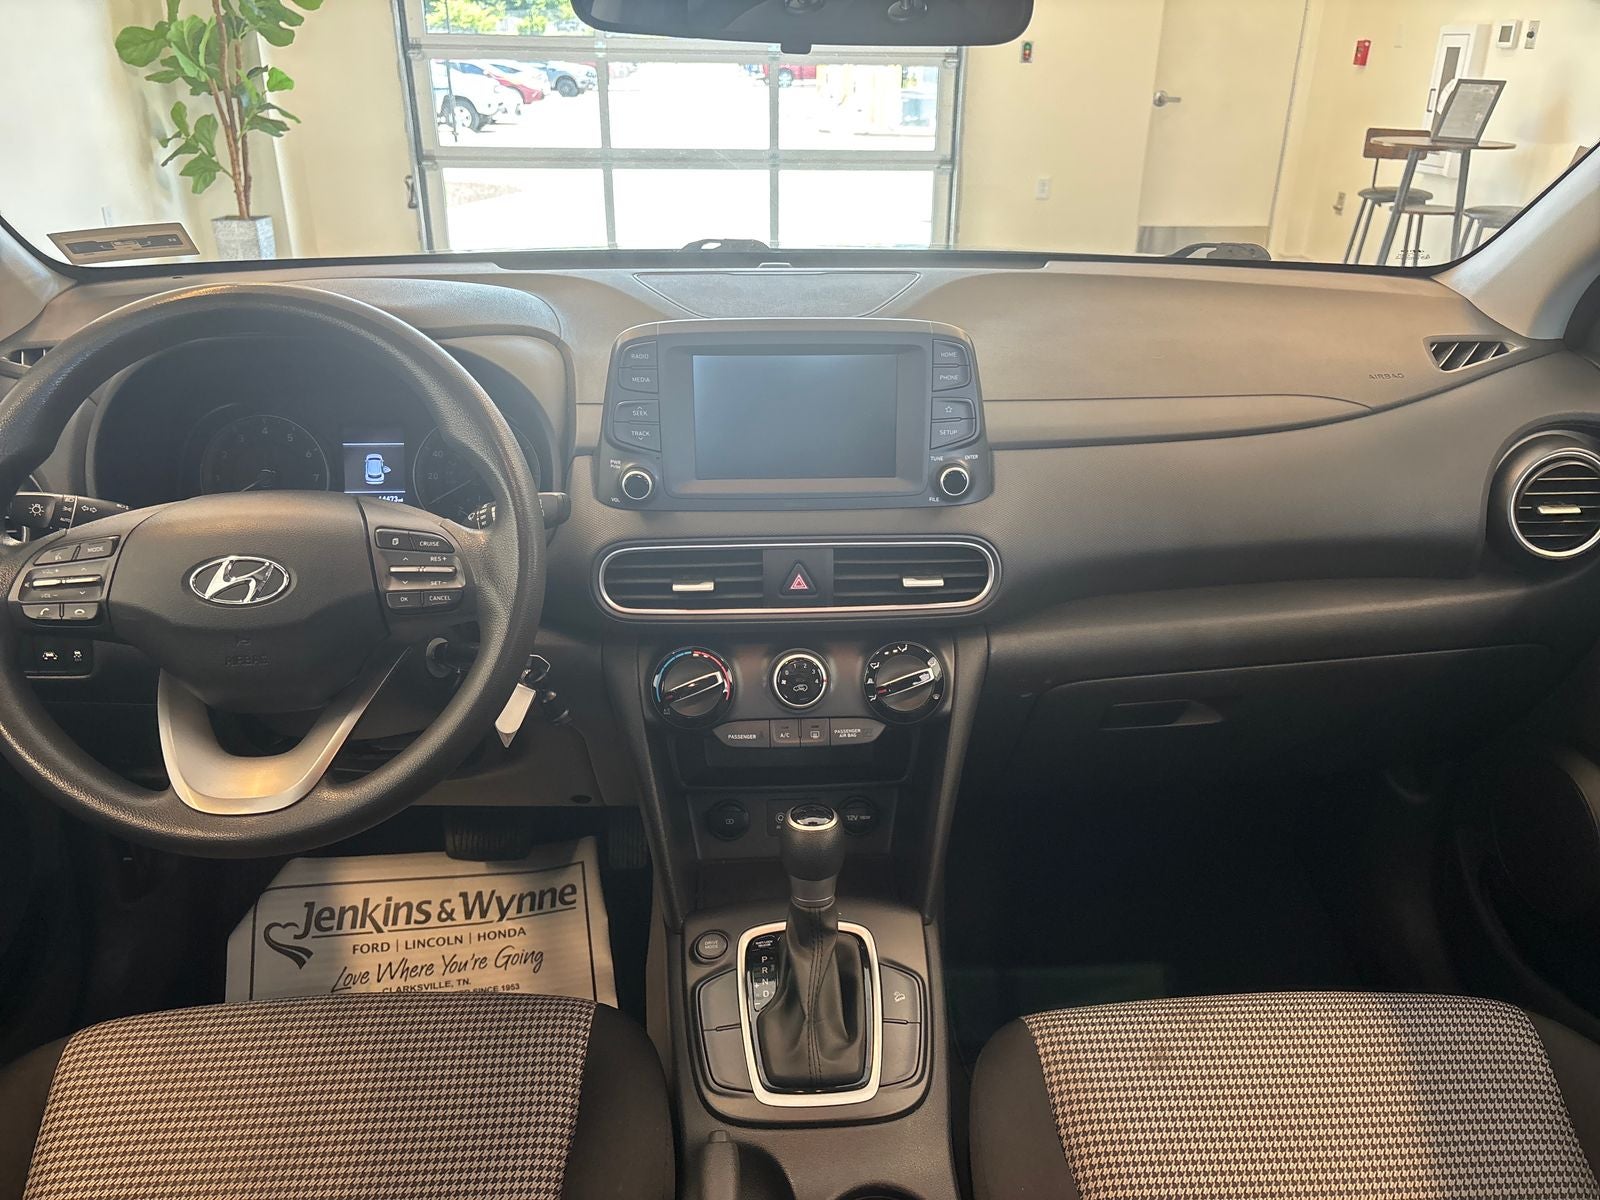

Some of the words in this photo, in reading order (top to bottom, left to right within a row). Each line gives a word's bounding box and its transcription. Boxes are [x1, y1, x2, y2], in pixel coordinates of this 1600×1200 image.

[293, 896, 433, 940] Jenkins
[436, 898, 457, 922] &
[459, 883, 578, 922] Wynne
[352, 941, 391, 955] FORD
[404, 934, 464, 950] LINCOLN
[477, 927, 527, 942] HONDA
[761, 955, 768, 963] P
[331, 966, 371, 994] Love
[376, 957, 435, 984] Where
[441, 953, 488, 977] You're
[494, 945, 545, 974] Going
[761, 966, 768, 974] R
[456, 978, 472, 986] TN.
[761, 978, 769, 986] N
[473, 985, 499, 993] SINCE
[501, 983, 520, 992] 1953
[762, 990, 770, 998] D
